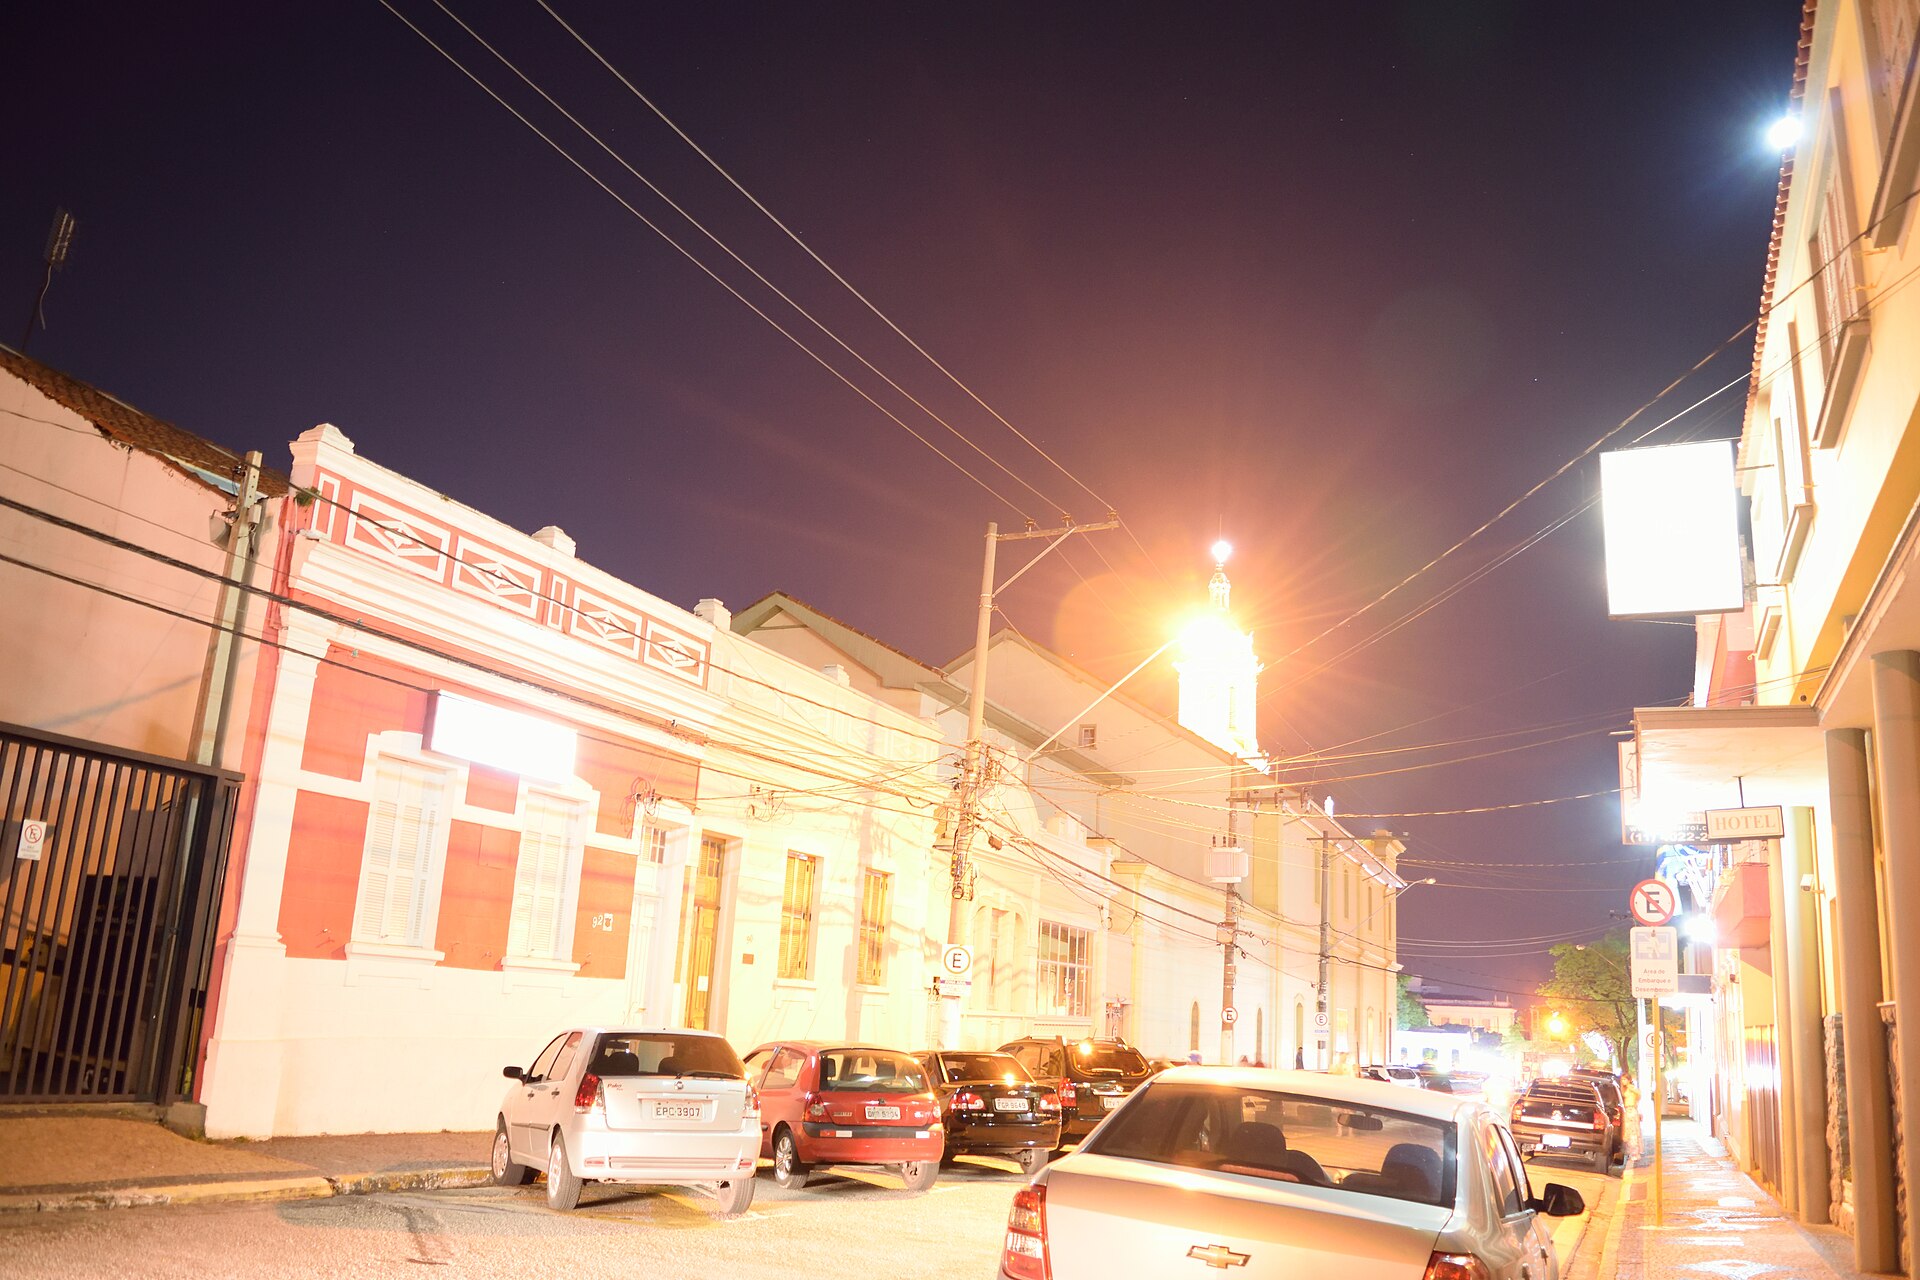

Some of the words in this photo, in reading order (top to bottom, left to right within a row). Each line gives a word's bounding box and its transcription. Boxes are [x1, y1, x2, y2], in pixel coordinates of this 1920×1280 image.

[1715, 814, 1776, 831] HOTEL
[1646, 891, 1661, 913] E
[953, 953, 962, 968] E
[1638, 977, 1667, 985] Embarque
[1635, 986, 1674, 994] Desembarque
[1319, 1015, 1324, 1024] E
